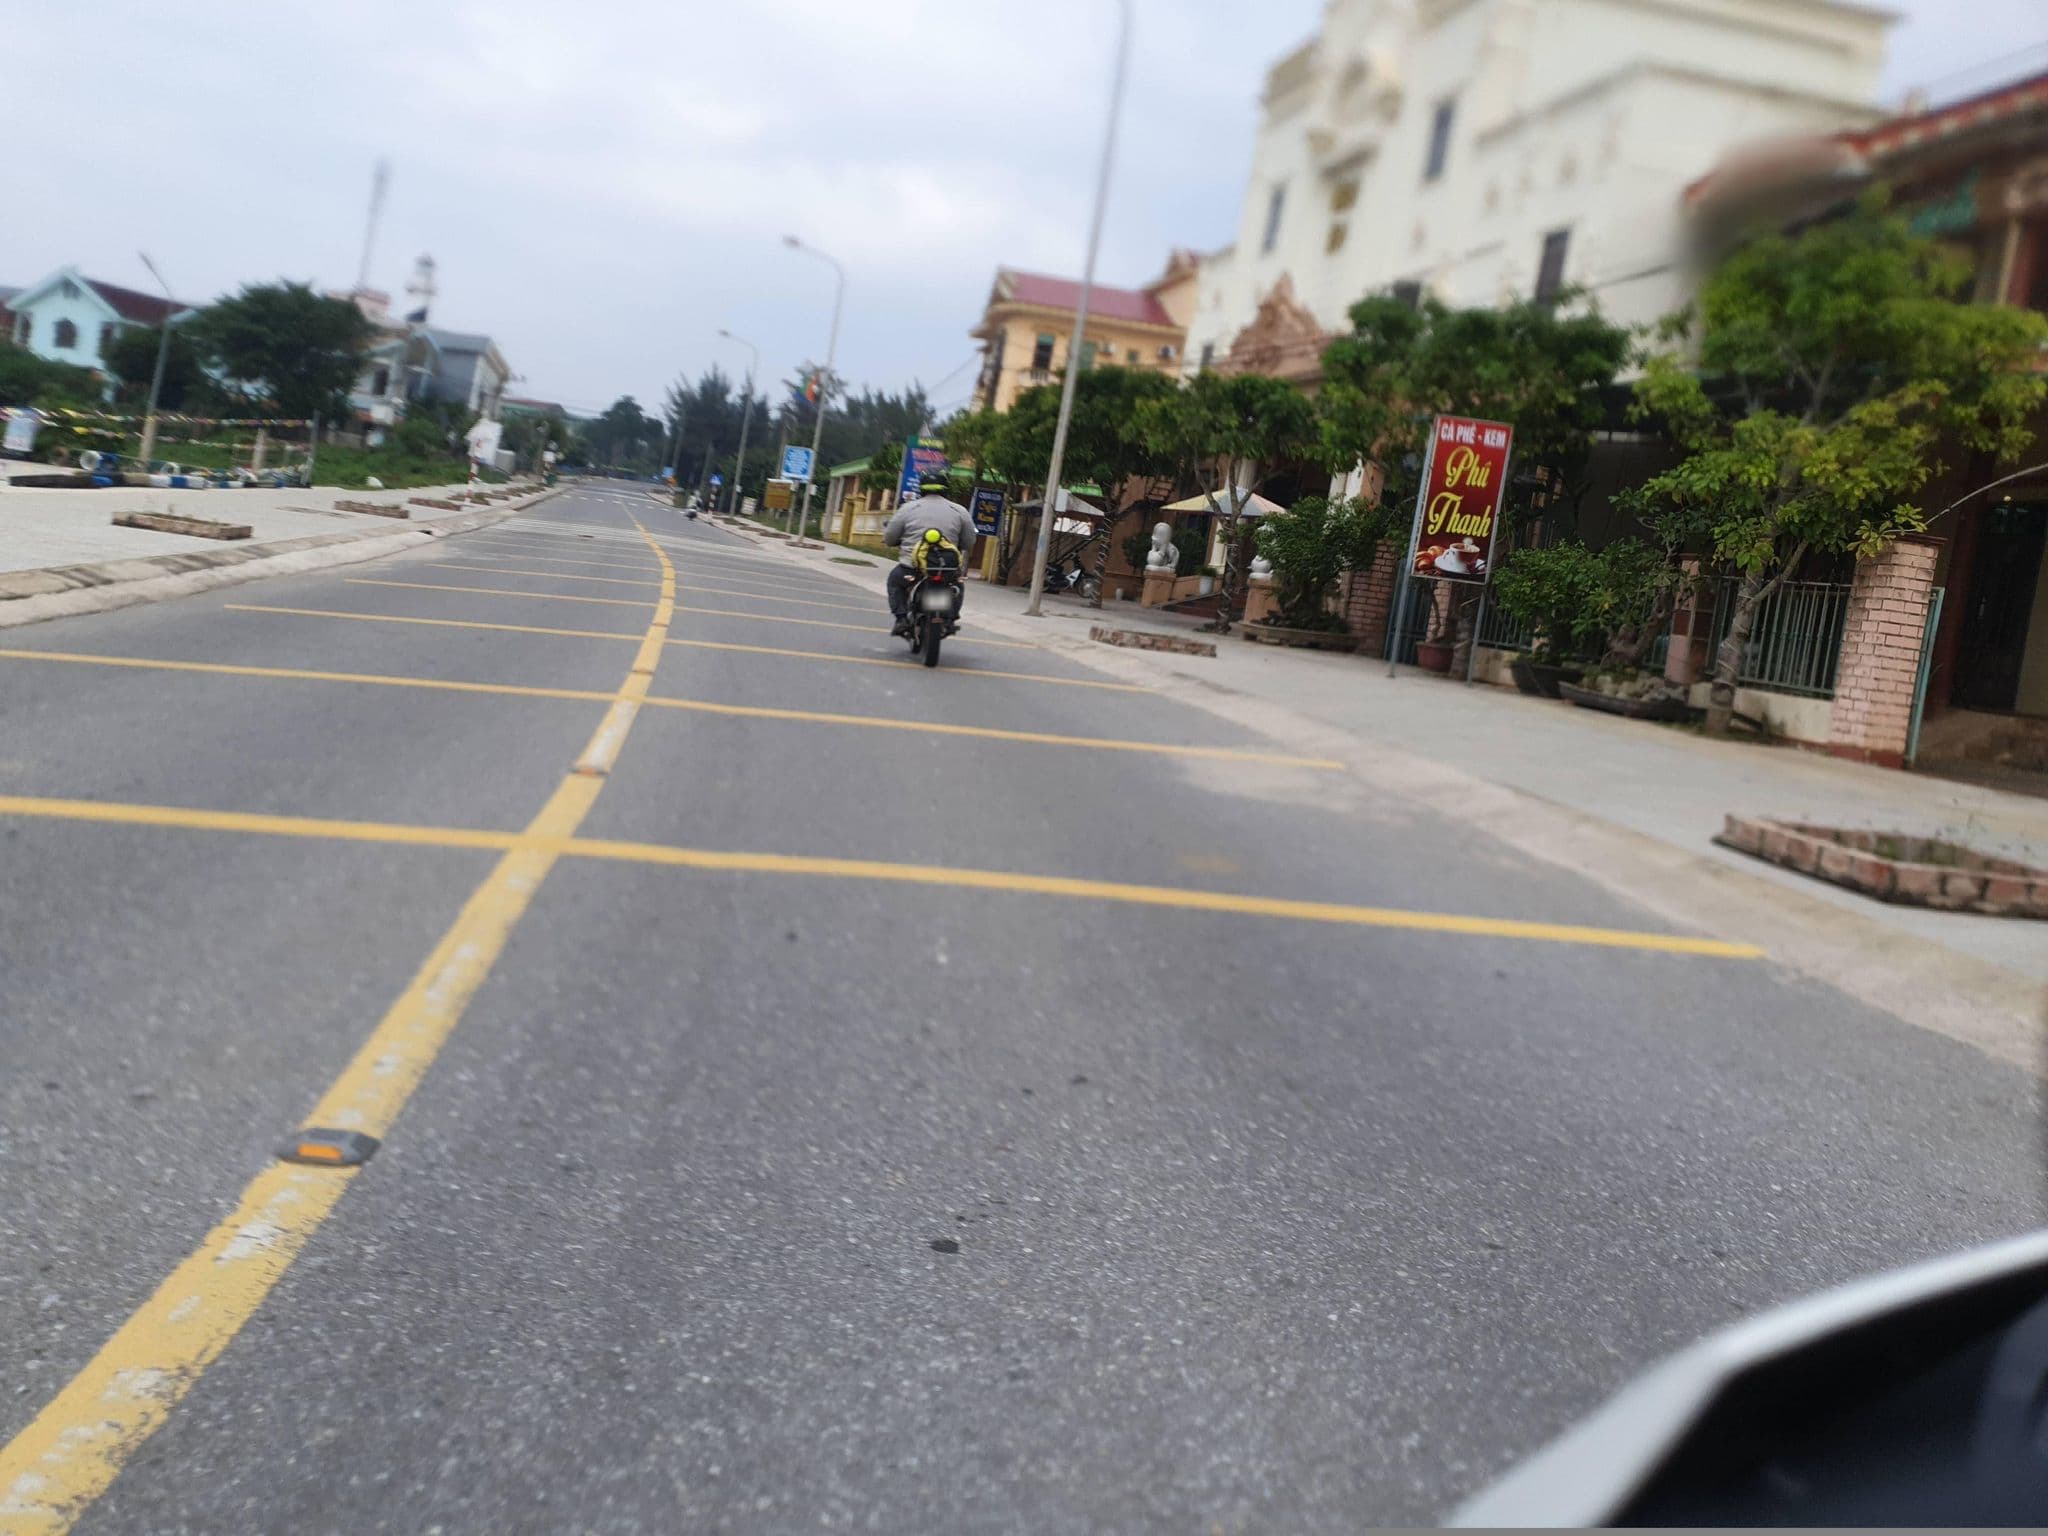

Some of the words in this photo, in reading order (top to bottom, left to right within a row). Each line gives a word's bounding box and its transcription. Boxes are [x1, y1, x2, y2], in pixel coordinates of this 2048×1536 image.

[1484, 428, 1506, 447] KEM
[1445, 446, 1492, 488] Phú
[1427, 491, 1492, 538] Thanh
